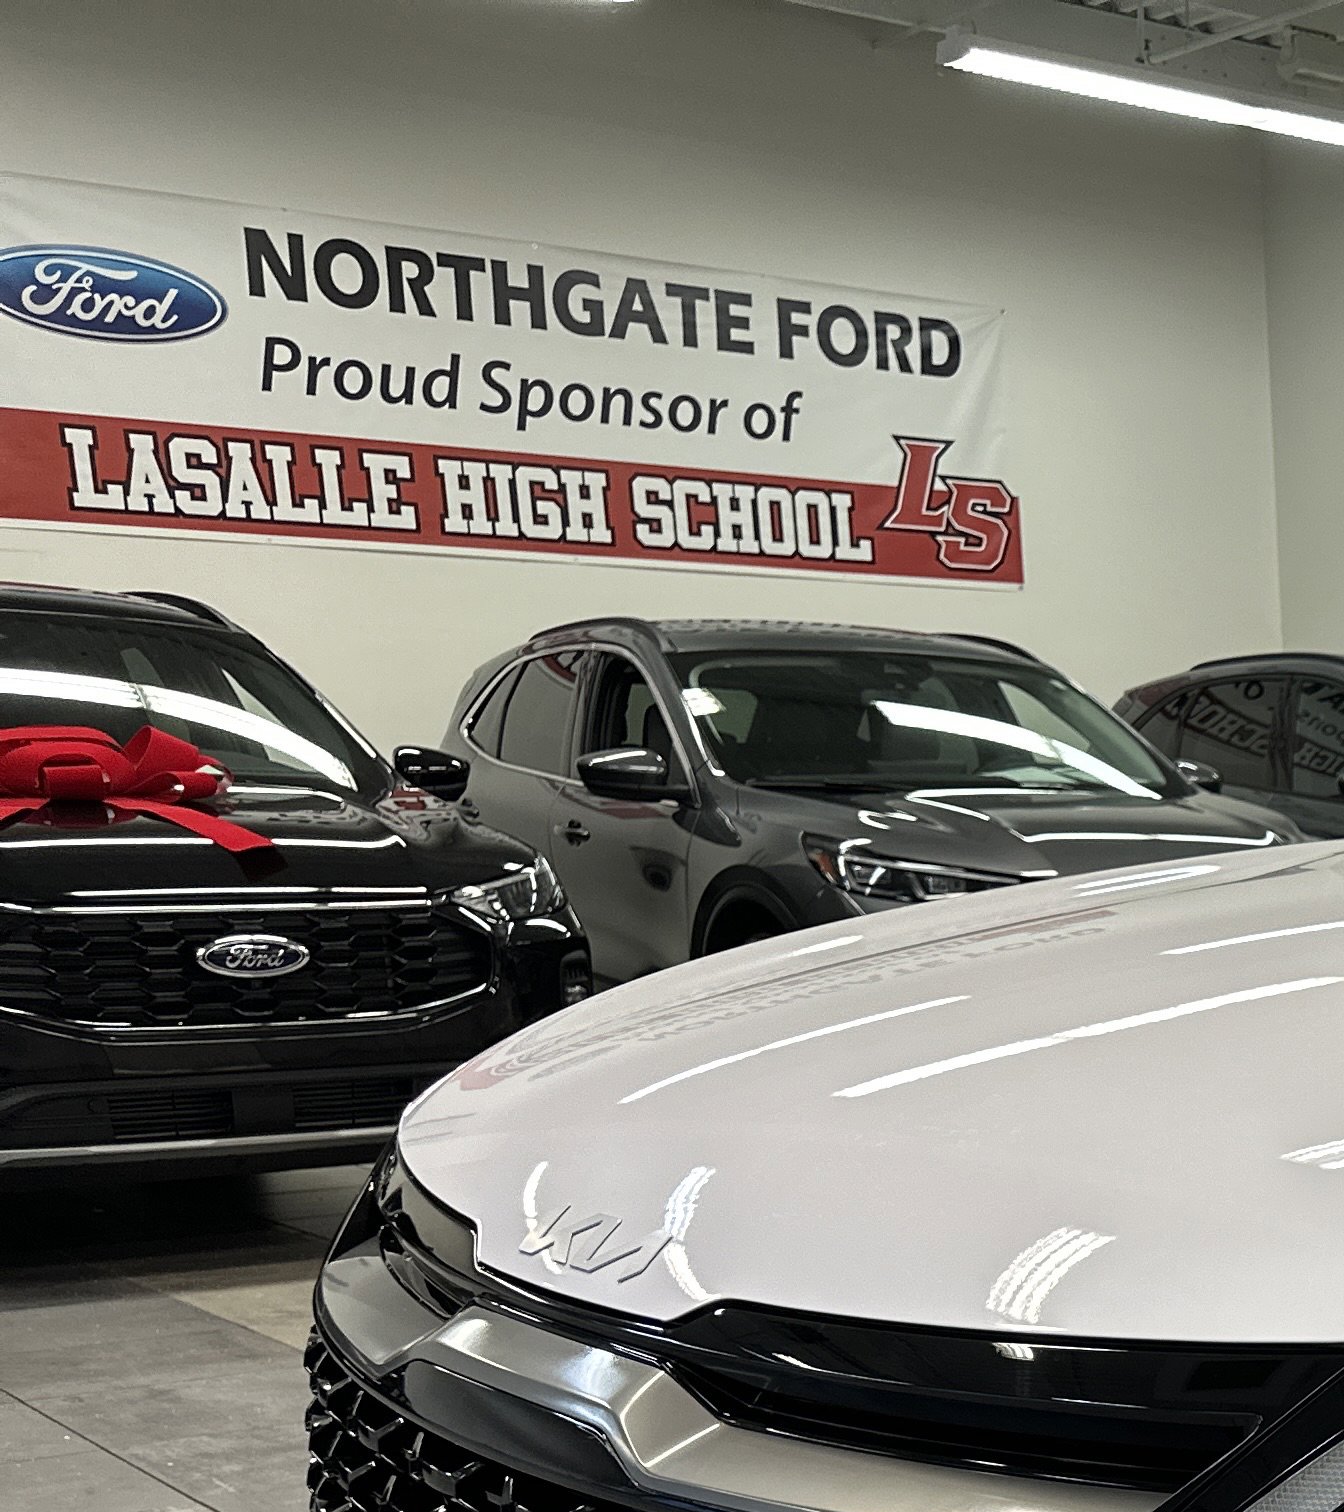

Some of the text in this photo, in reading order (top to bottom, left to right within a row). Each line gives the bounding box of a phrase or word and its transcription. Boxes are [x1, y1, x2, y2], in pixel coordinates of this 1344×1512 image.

[20, 256, 180, 330] Ford
[243, 226, 962, 378] NORTHGATE FORD
[261, 336, 803, 442] Proud Sponsor of
[59, 424, 876, 565] LASALLE HIGH SCHOOL
[877, 435, 1018, 572] LS
[226, 944, 285, 968] Ford
